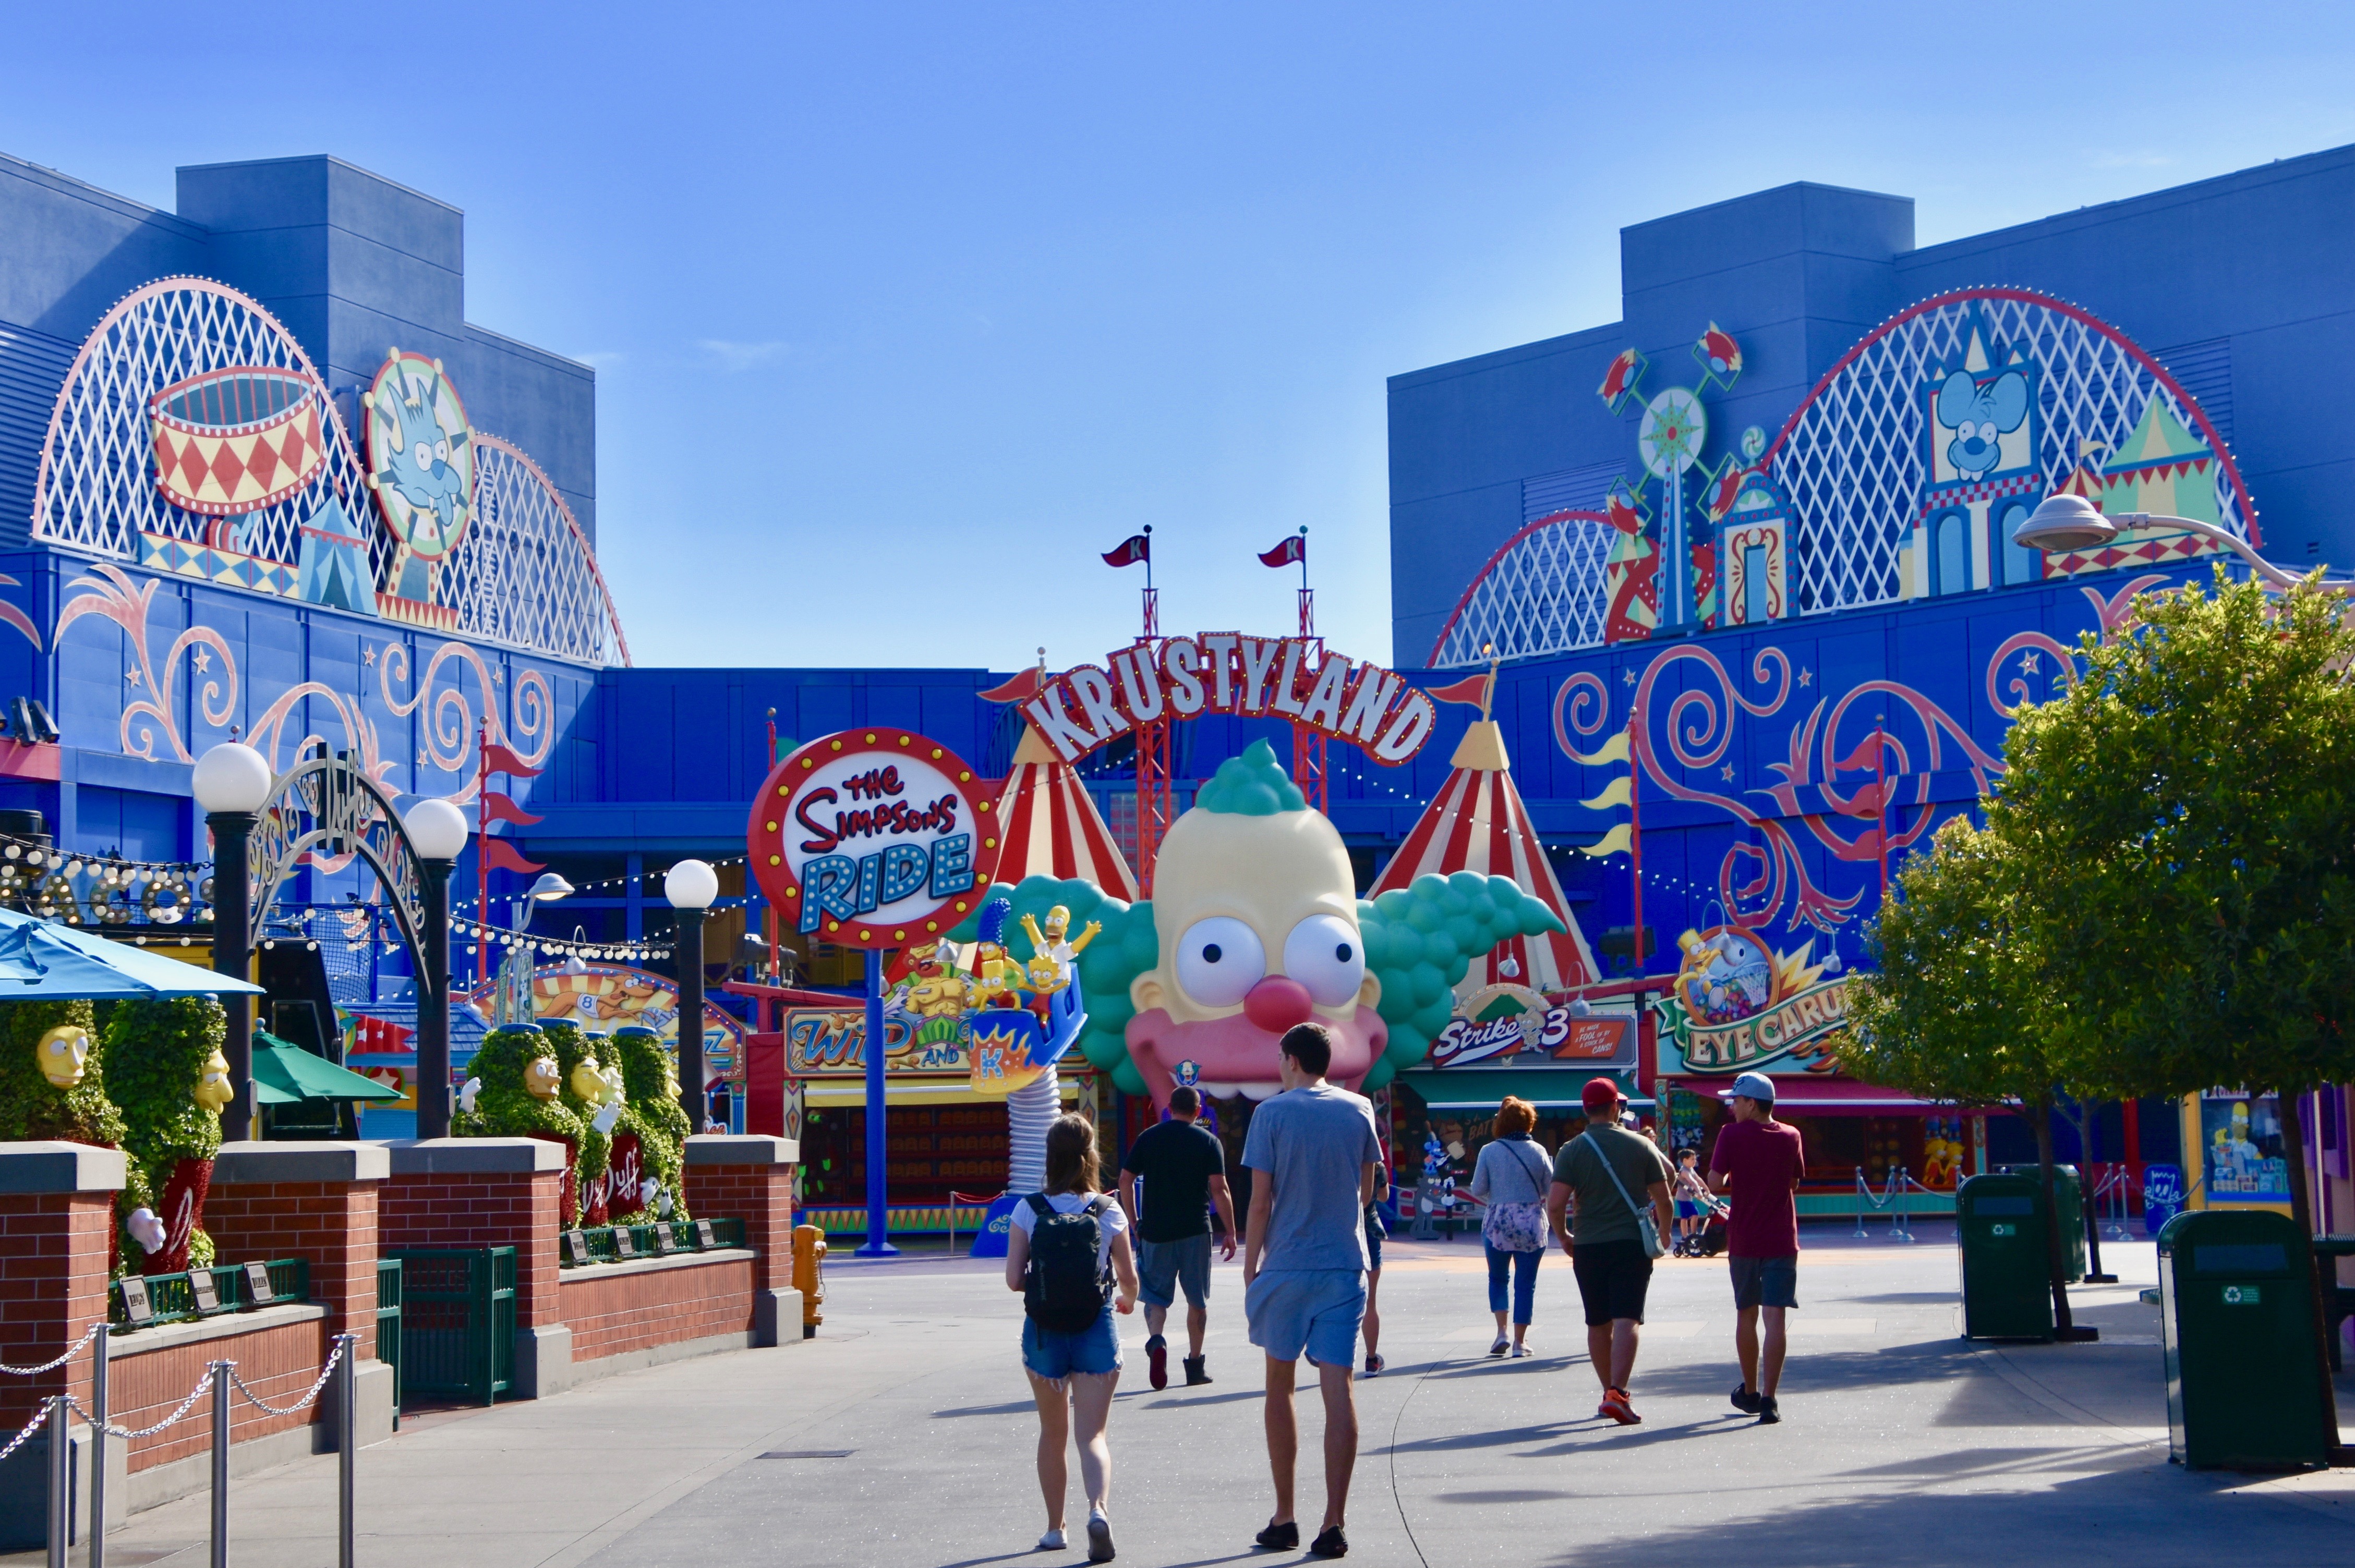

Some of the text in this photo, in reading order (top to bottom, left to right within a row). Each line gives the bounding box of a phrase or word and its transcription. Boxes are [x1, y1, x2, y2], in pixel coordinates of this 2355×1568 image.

[1130, 539, 1142, 561] K
[1286, 539, 1299, 561] K
[1025, 634, 1434, 763] KRUSTYLAND
[797, 833, 975, 935] RIDE
[582, 996, 593, 1008] 8
[1433, 1008, 1569, 1056] Strike 3
[1579, 1031, 1595, 1042] FOOL
[920, 1044, 960, 1067] AND
[1592, 1042, 1613, 1054] CANS!
[1689, 1024, 1757, 1064] EYE
[981, 1048, 1003, 1079] K
